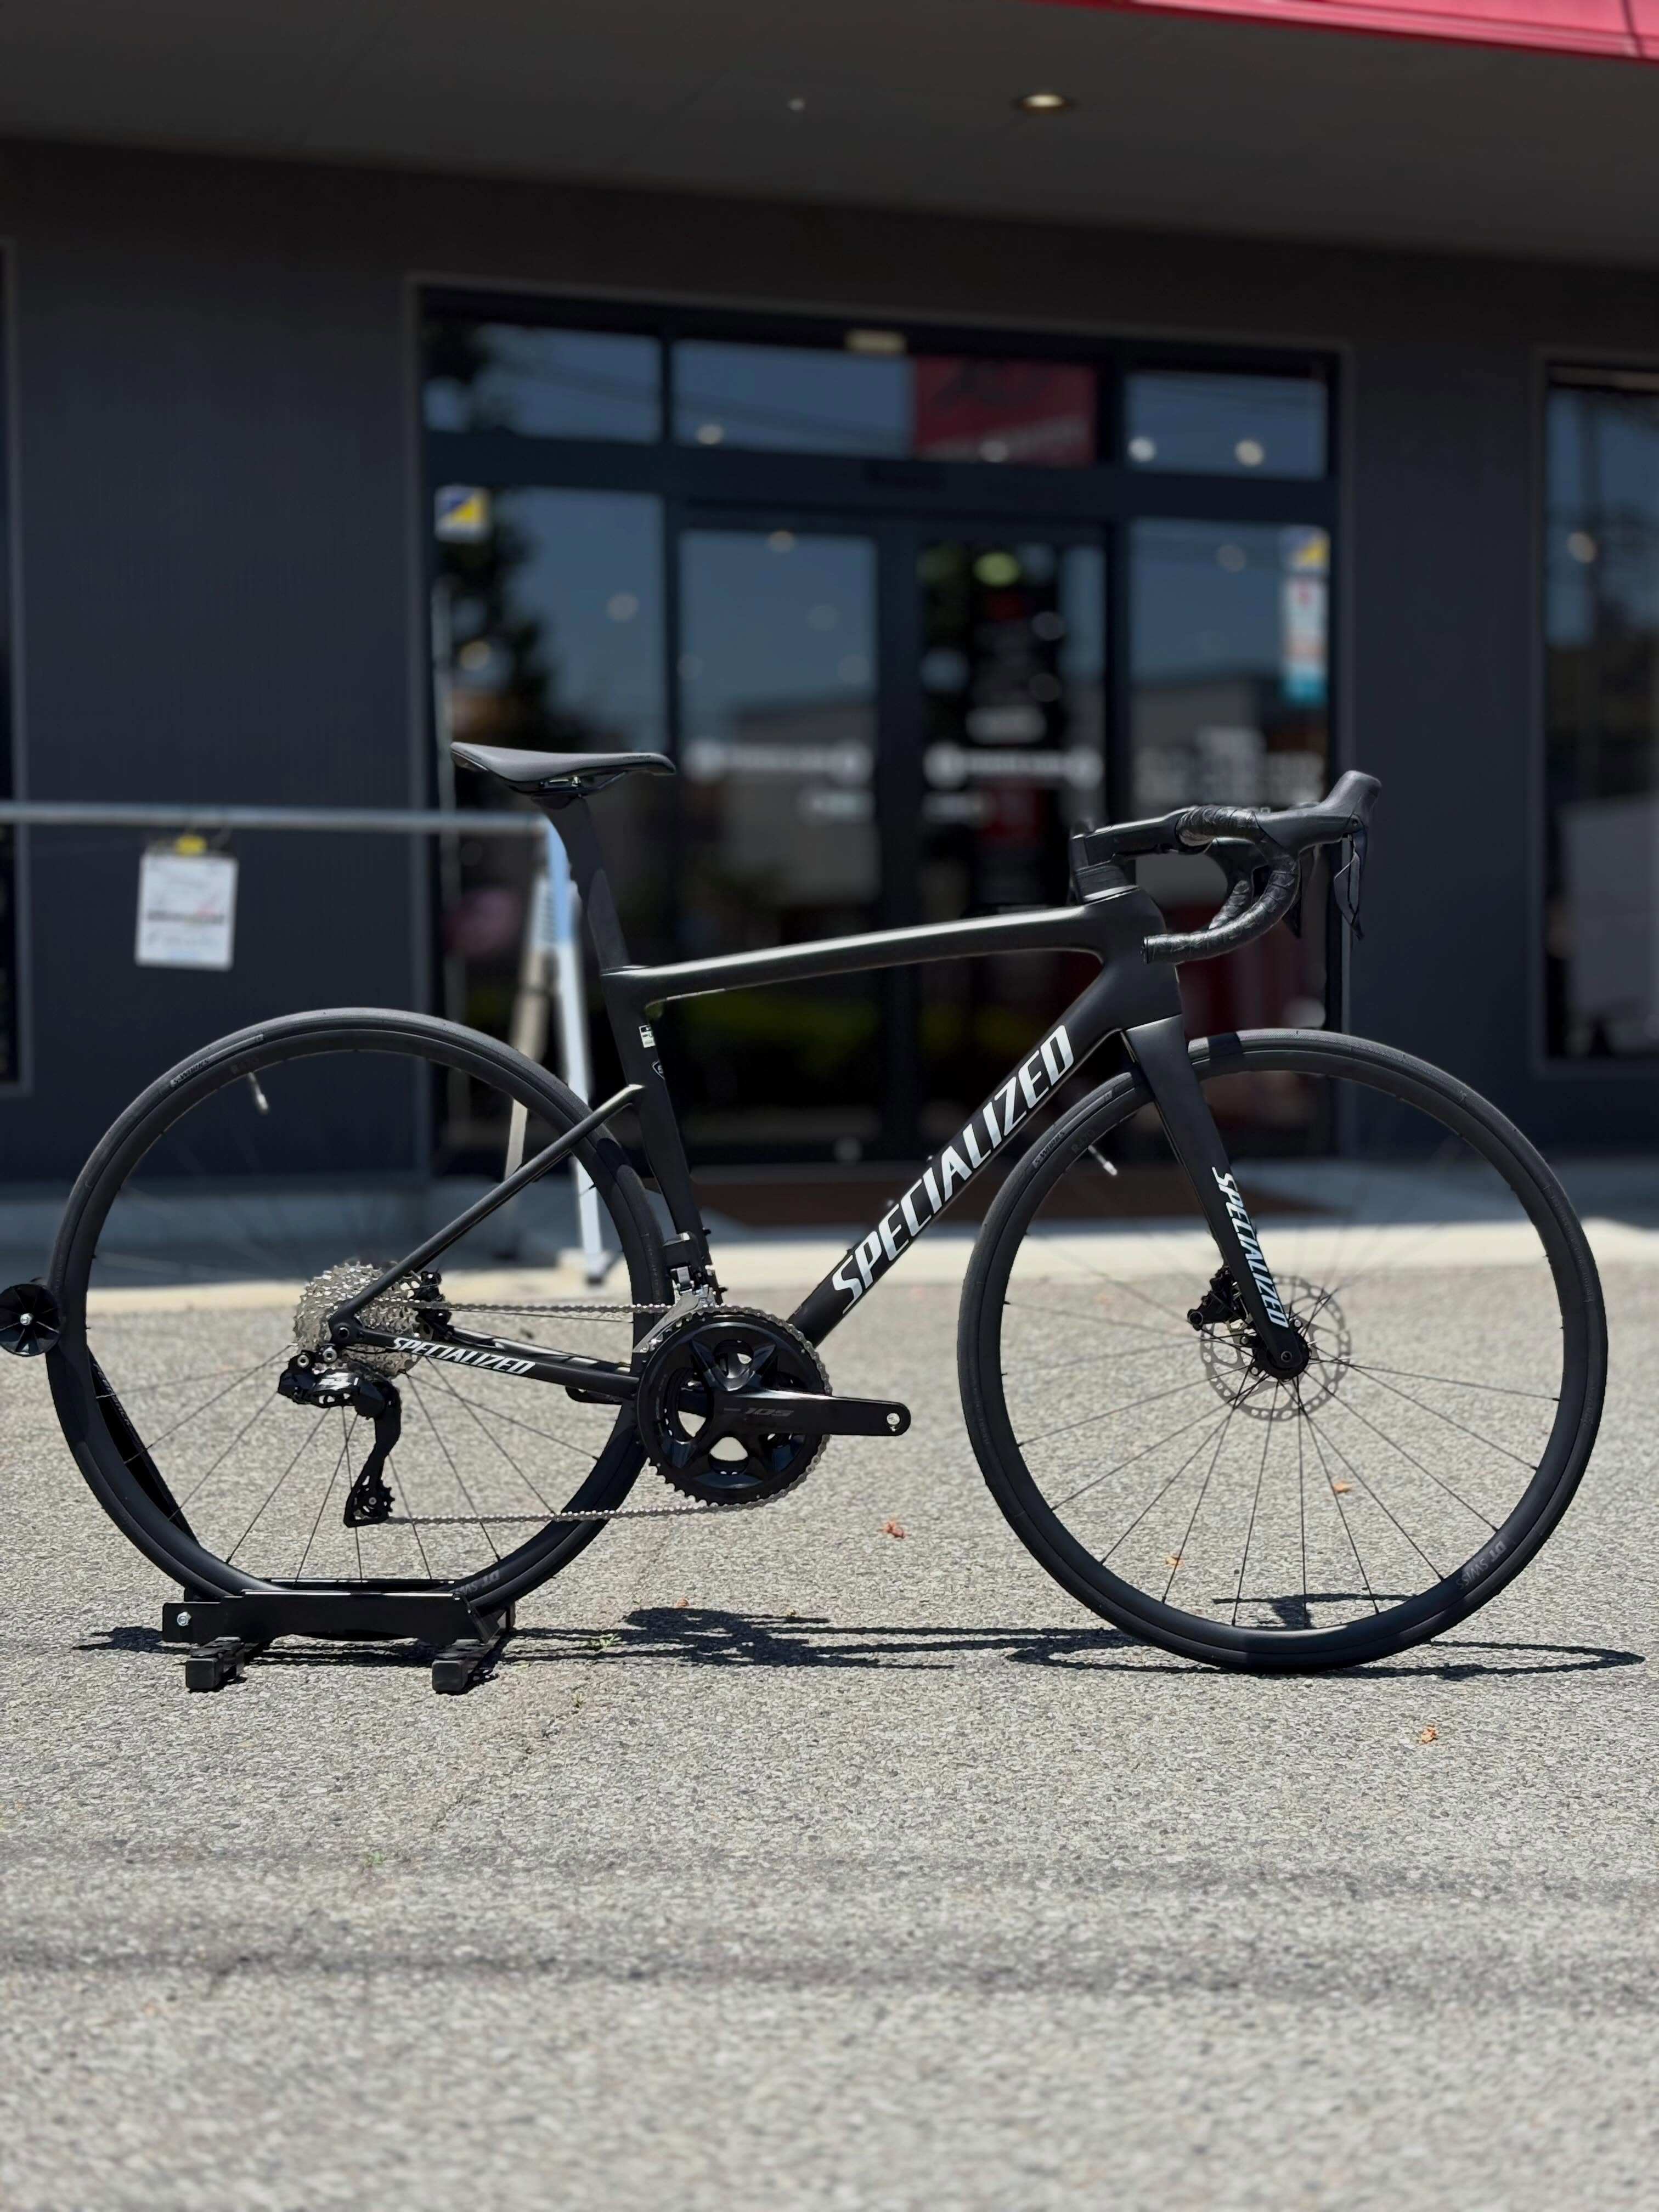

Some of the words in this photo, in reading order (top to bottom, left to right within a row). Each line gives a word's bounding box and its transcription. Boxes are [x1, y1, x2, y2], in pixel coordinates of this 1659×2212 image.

[832, 1025, 1074, 1314] SPECIALIZED
[1211, 1166, 1289, 1328] SPECIALIZED
[391, 1336, 536, 1375] SPECIALIZED
[744, 1407, 795, 1417] 105
[1489, 1541, 1507, 1562] DT
[1457, 1559, 1488, 1589] SWISS
